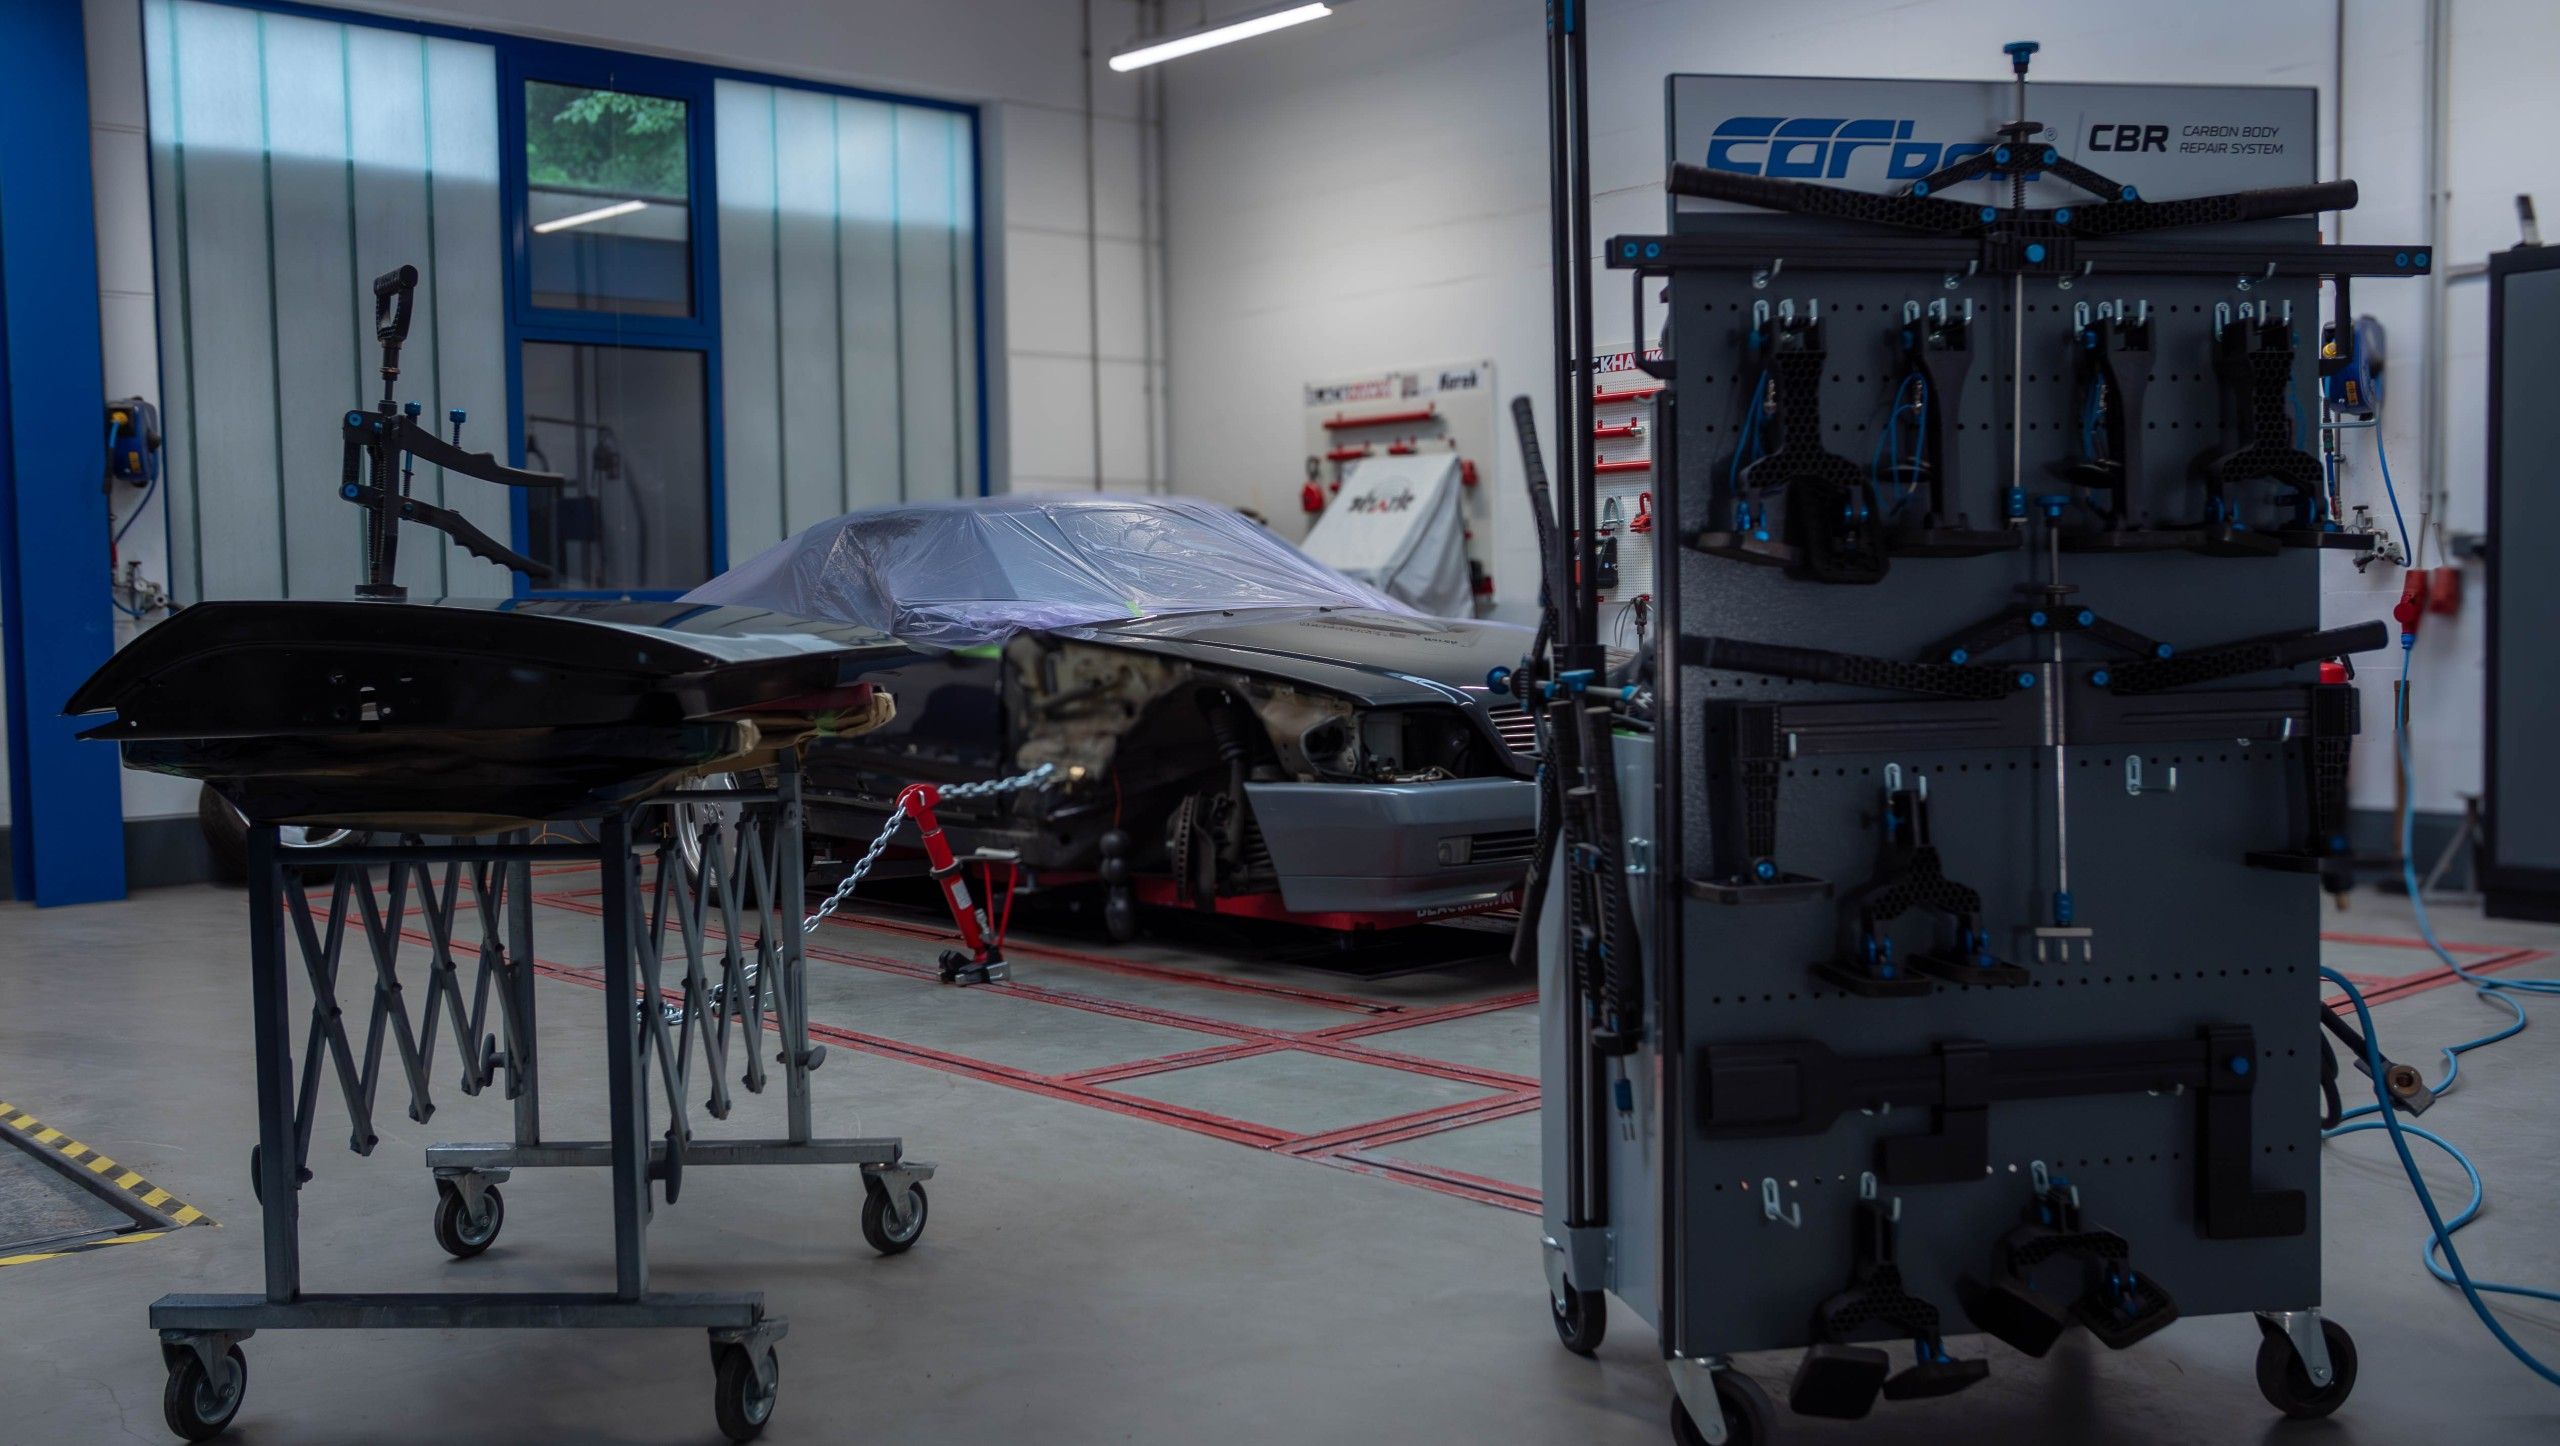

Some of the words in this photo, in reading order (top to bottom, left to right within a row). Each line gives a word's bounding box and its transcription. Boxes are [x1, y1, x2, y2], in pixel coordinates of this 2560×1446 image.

[2088, 124, 2170, 152] CBR
[2182, 125, 2239, 138] CARBON
[2242, 126, 2280, 138] BODY
[1706, 117, 2040, 181] carbo
[2179, 142, 2228, 154] REPAIR
[2230, 143, 2284, 155] SYSTEM
